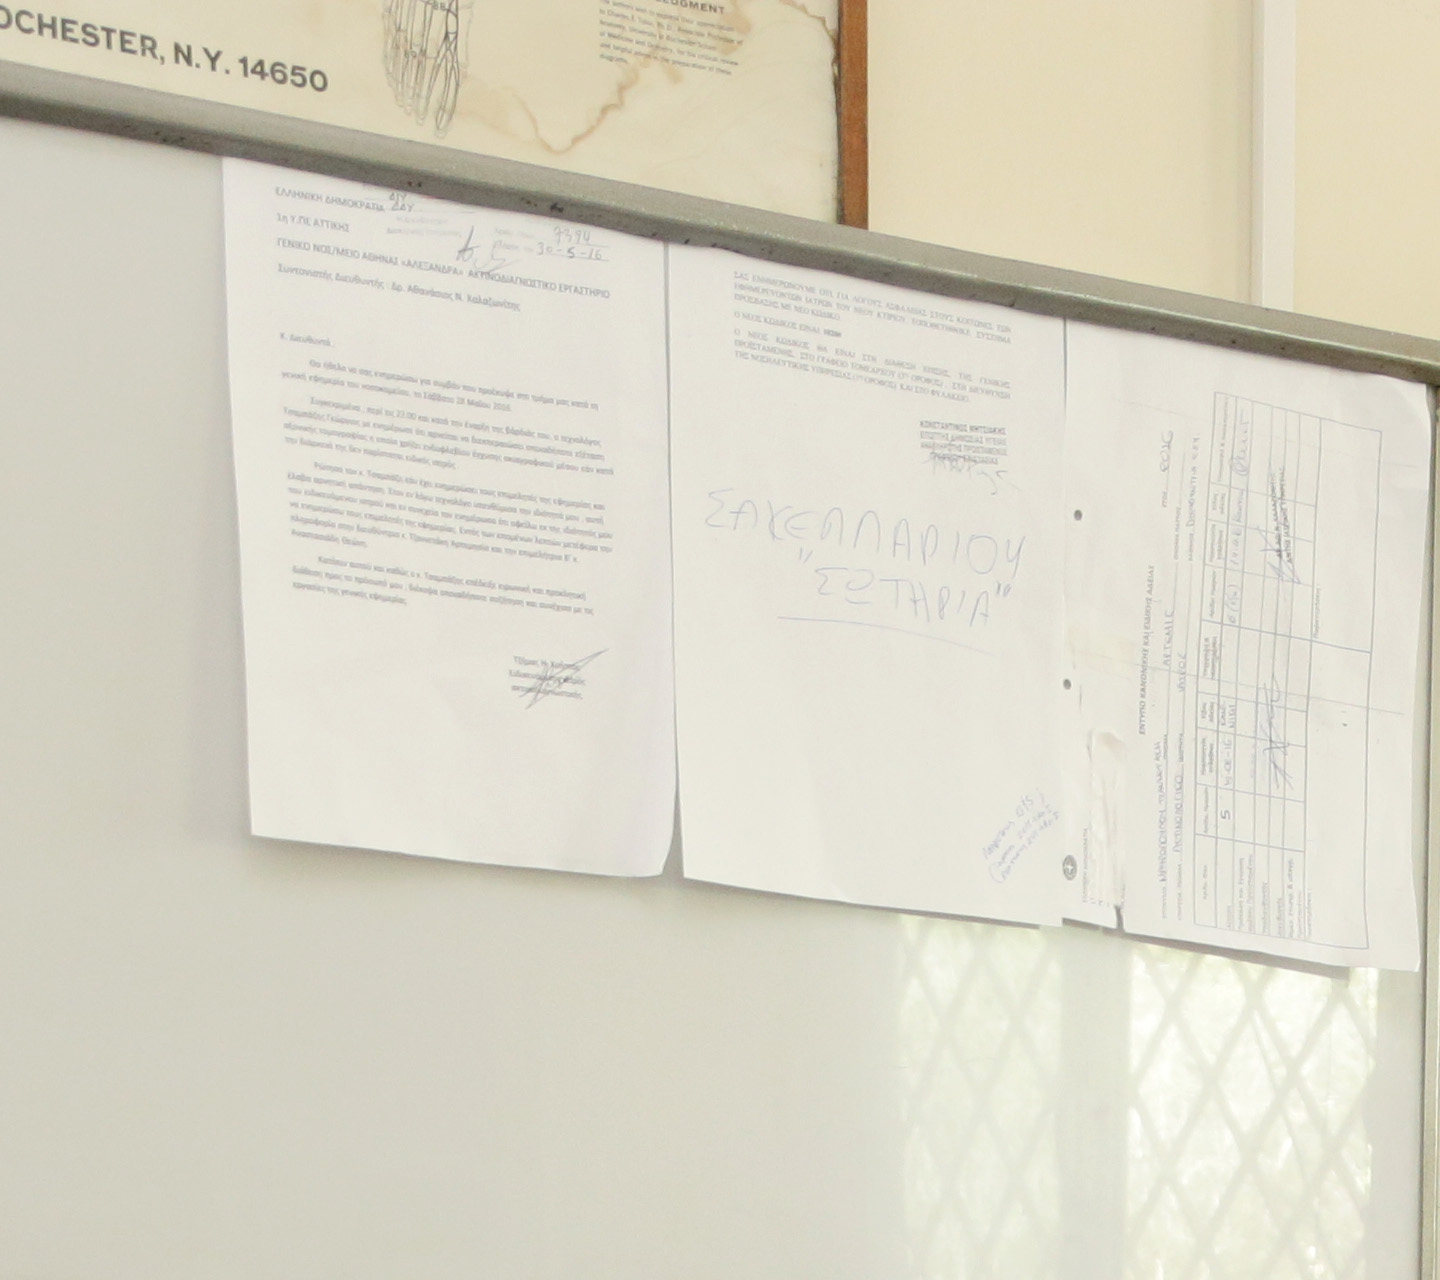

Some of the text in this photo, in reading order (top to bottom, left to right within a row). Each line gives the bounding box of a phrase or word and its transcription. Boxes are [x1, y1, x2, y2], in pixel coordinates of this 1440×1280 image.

[173, 42, 231, 75] N.Y.
[238, 56, 329, 93] 14650
[275, 186, 385, 212] ΕΛΛΗΝΙΚΗ ΔΗΜΟΚΡΑΤΙΑ
[291, 214, 311, 227] Υ.ΠΕ
[313, 218, 350, 232] ΑΤΤΙΚΗΣ
[277, 238, 310, 250] ΓΕΝΙΚΟ
[312, 243, 360, 259] ΝΟΣ/ΜΕΙΟ
[362, 252, 399, 266] ΑΘΗΝΑΣ
[468, 269, 557, 291] ΑΚΤΙΝΟΔΙΑΓΝΩΣΤΙΚΟ
[559, 282, 610, 299] ΕΡΓΑΣΤΗΡΙΟ
[278, 263, 334, 282] Συντονιστής
[335, 272, 385, 290] Διευθυντής
[1145, 564, 1155, 596] ΑΔΕΙΑΣ
